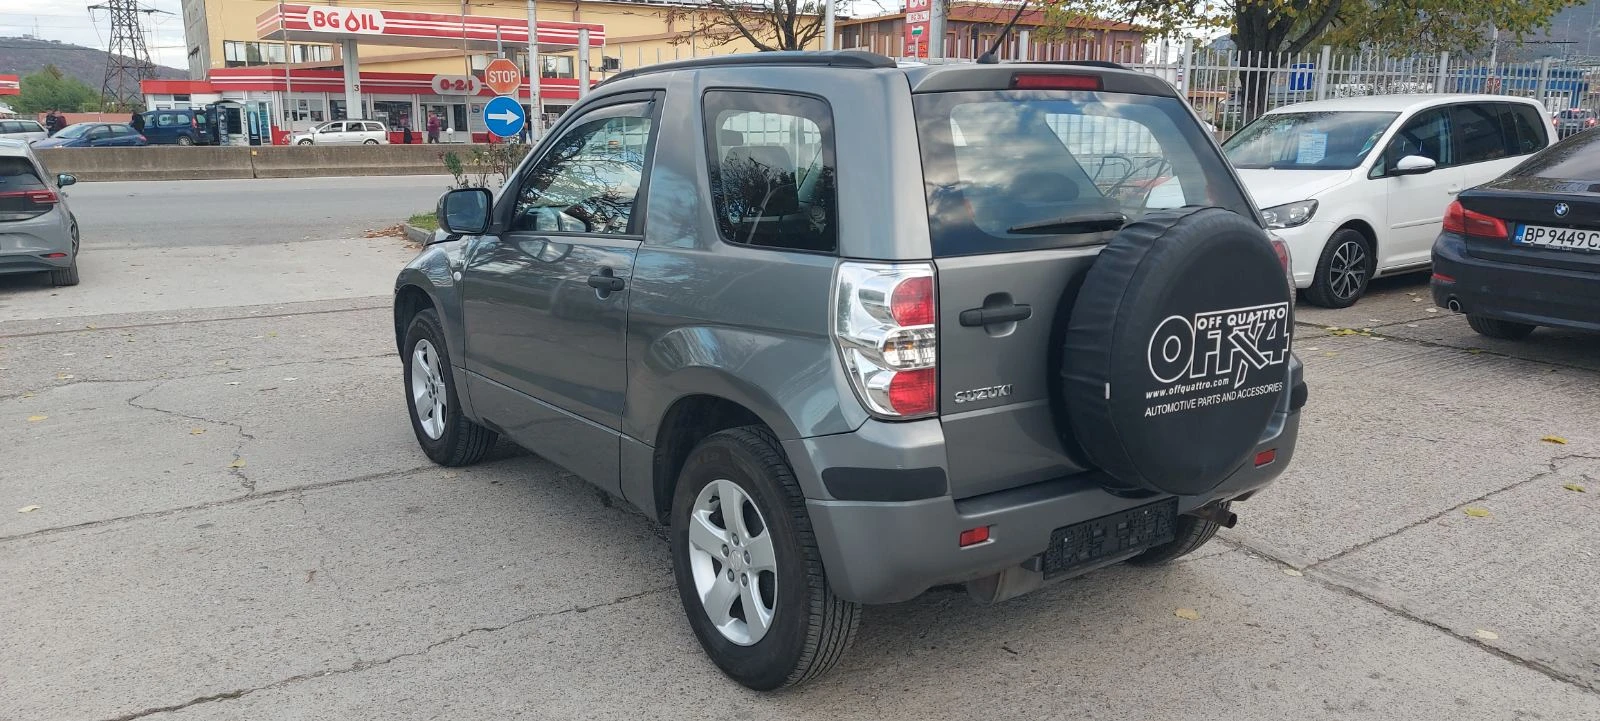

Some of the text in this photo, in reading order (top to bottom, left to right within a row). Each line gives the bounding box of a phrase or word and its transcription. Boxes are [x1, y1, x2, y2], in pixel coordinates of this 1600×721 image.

[314, 11, 339, 28] BG
[489, 70, 517, 83] STOP
[1525, 228, 1545, 242] BP
[1549, 230, 1586, 247] 9449
[1588, 233, 1600, 248] C
[1197, 308, 1286, 330] OFF QUATTRO
[955, 384, 1013, 403] SUZUKI
[1146, 378, 1229, 399] www.offquattro.com
[1145, 382, 1283, 417] AUTOMOTIVE PARTS AND ACCESSORIES
